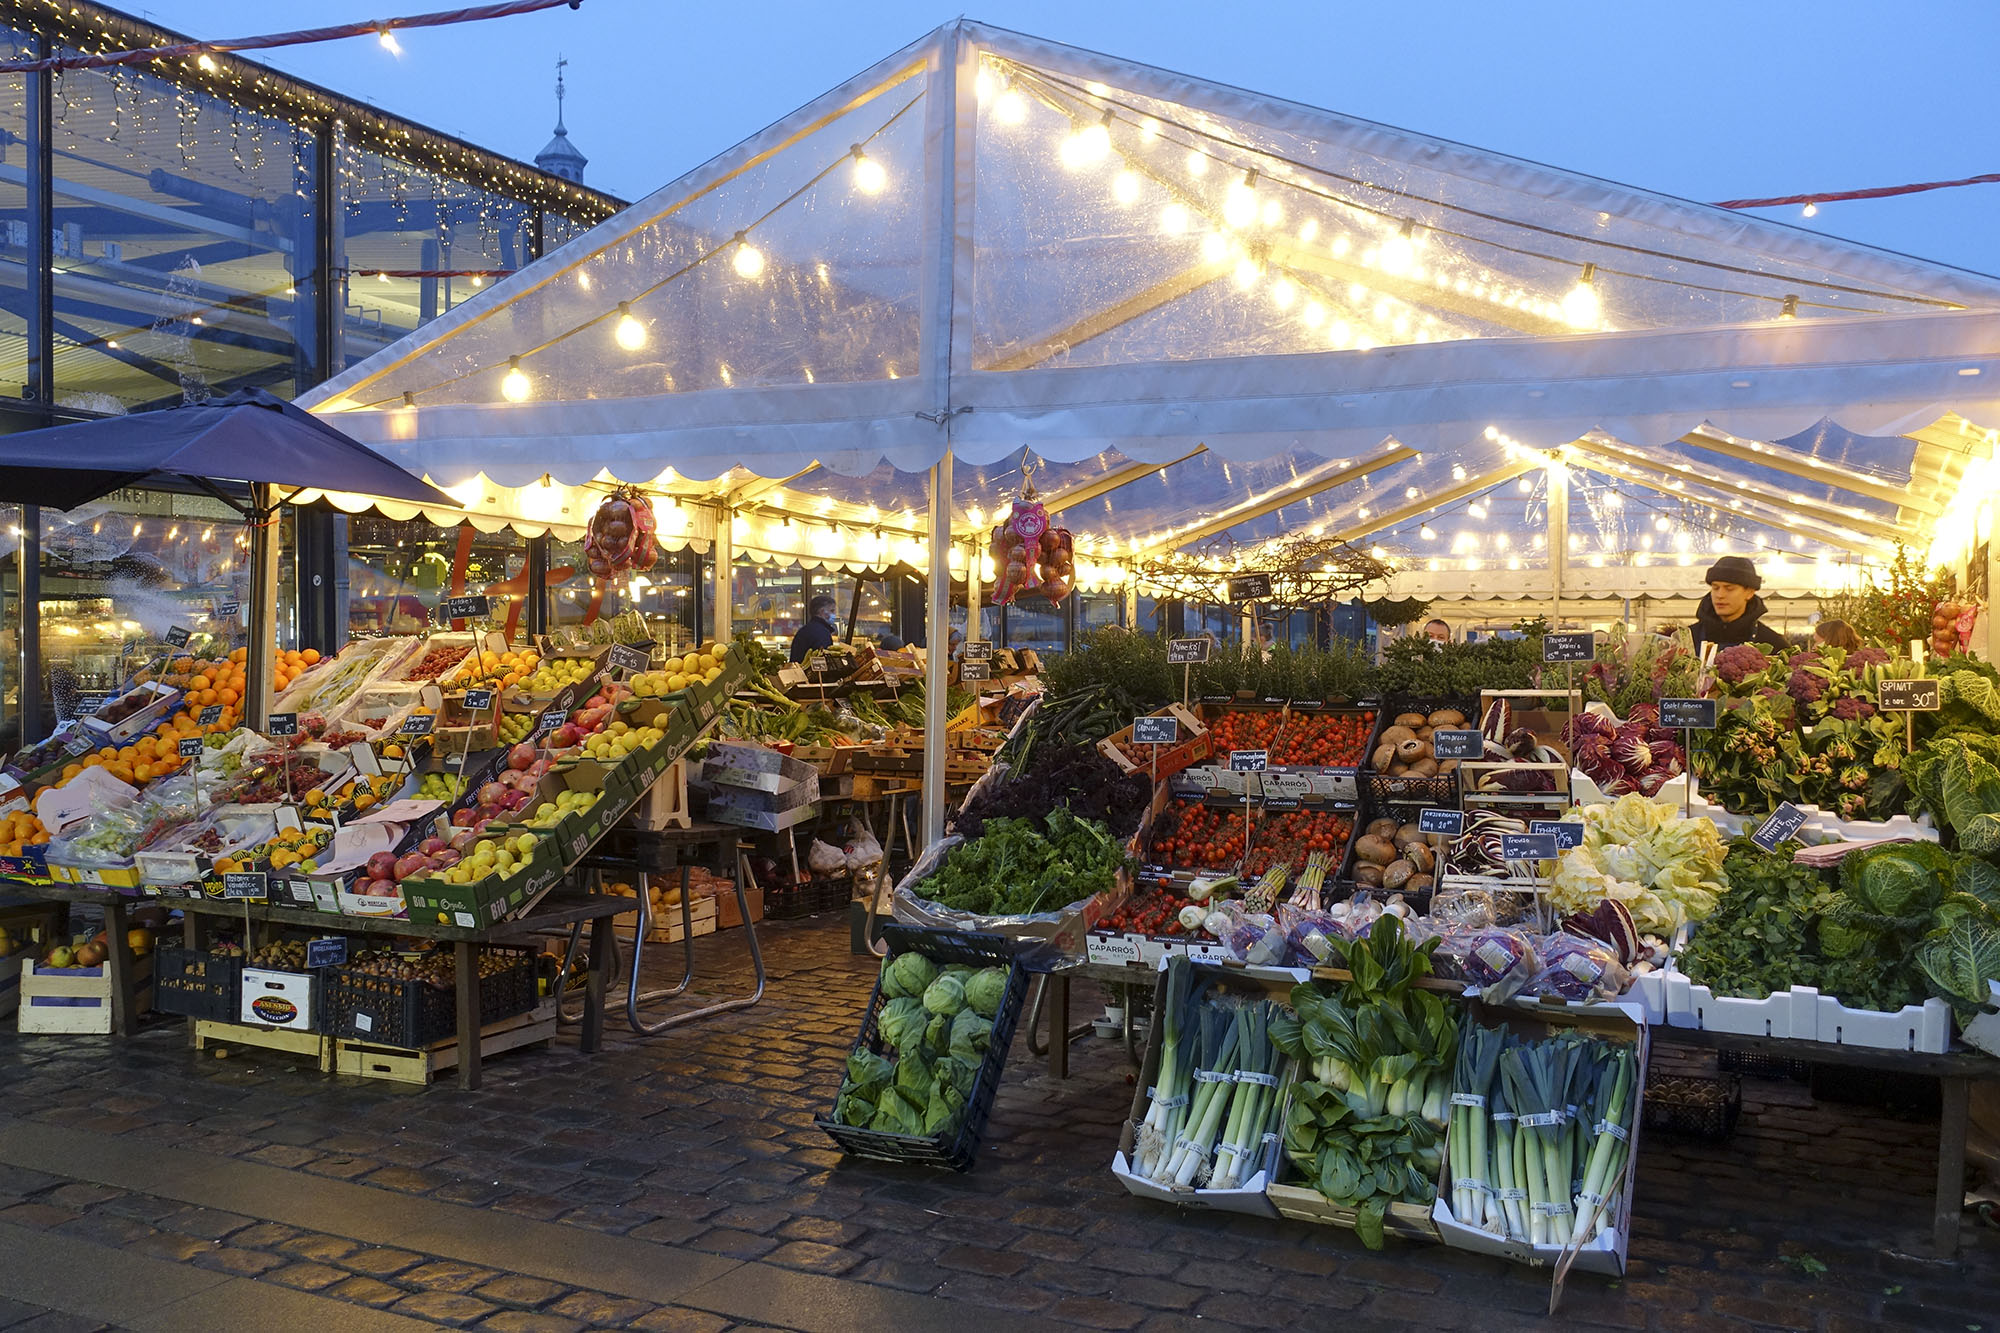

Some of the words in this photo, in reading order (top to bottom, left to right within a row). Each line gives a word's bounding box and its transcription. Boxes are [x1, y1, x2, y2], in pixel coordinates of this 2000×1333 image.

[1880, 682, 1914, 691] SPINAT
[1264, 780, 1308, 788] CAPARRÓS
[1762, 819, 1785, 842] MYNTE
[1089, 943, 1135, 955] CAPARRÓS
